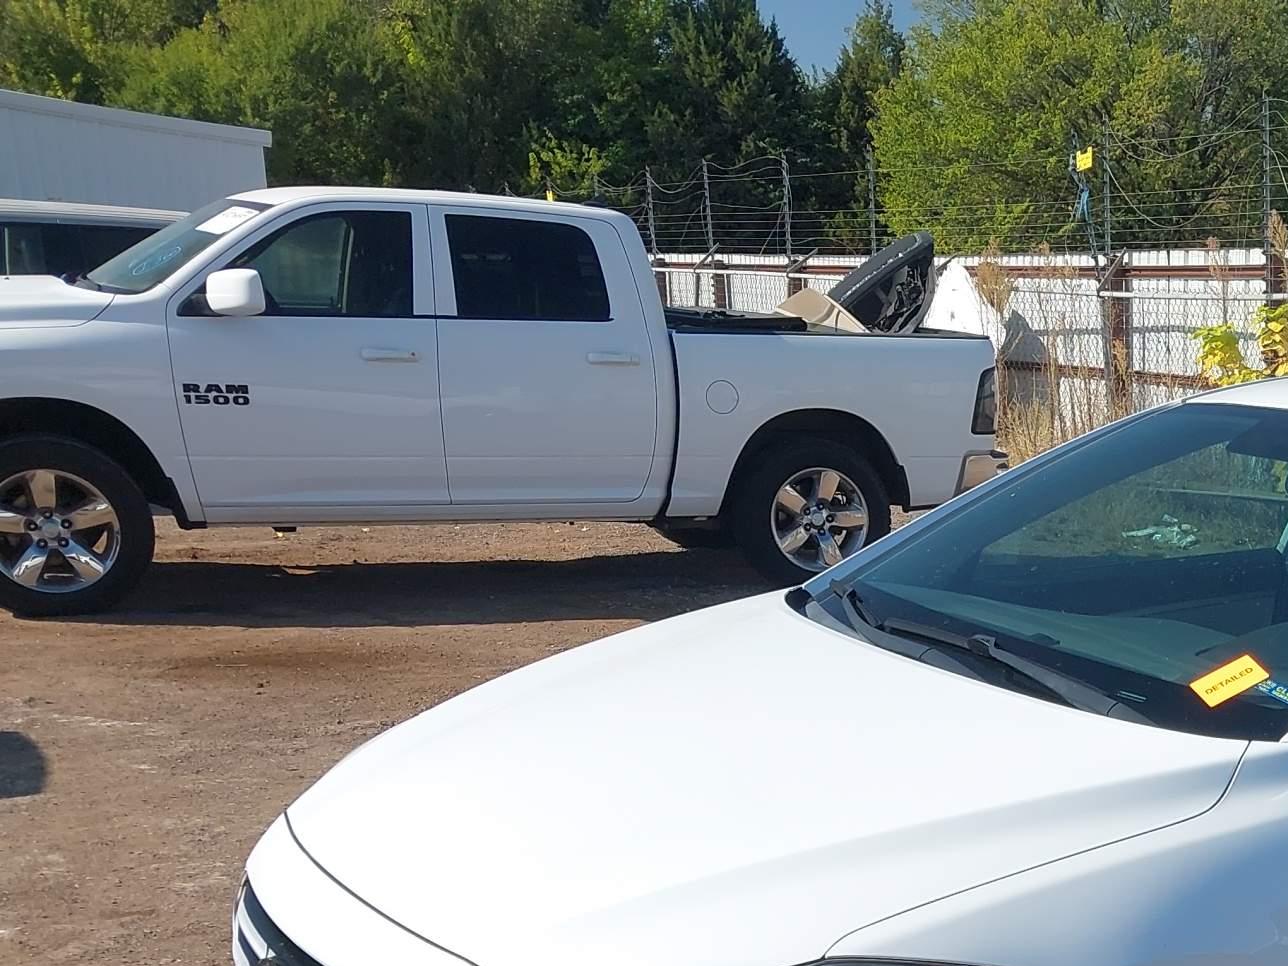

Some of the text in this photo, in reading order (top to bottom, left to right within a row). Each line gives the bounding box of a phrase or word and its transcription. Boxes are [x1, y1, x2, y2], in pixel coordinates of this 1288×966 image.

[182, 383, 249, 394] RAM
[183, 394, 250, 406] 1500
[1205, 667, 1254, 695] DETAILED
